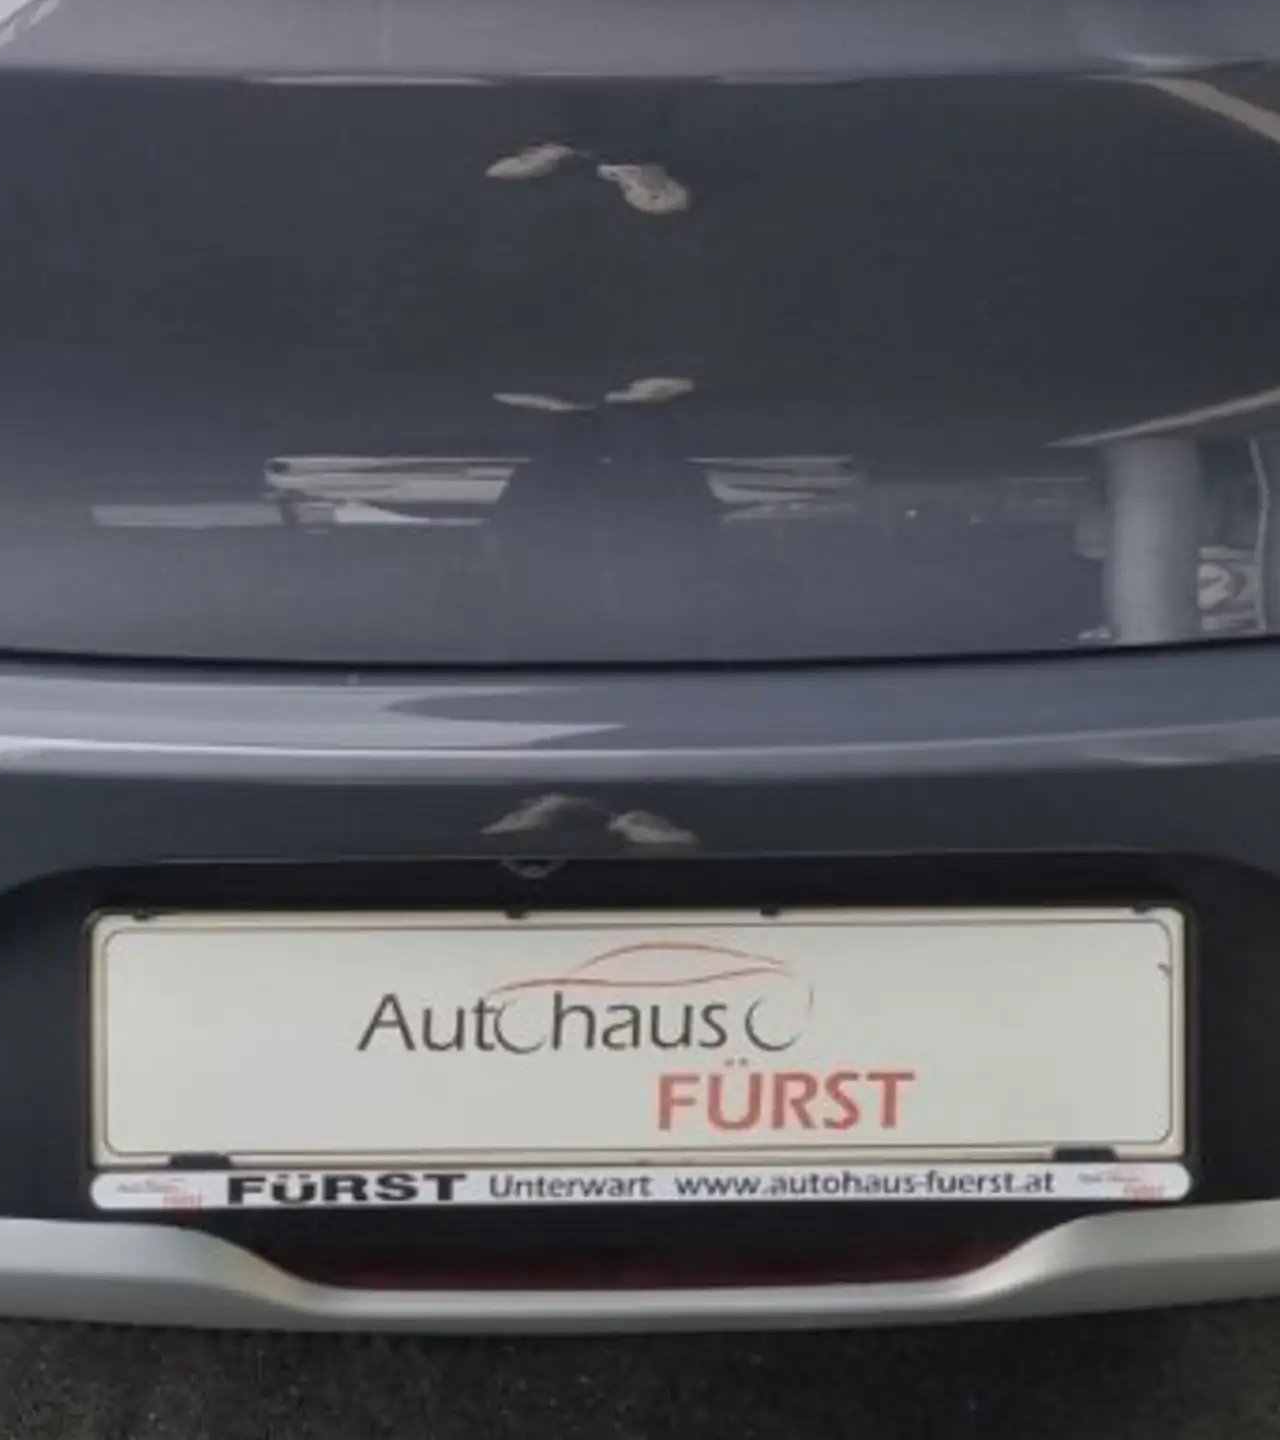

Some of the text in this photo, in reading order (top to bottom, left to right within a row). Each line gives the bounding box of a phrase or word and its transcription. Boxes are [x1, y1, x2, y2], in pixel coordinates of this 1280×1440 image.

[357, 990, 729, 1055] Autohaus
[657, 1057, 916, 1131] FÜRST
[227, 1172, 468, 1206] FÜRST
[489, 1174, 654, 1198] Unterwart
[674, 1169, 1055, 1195] www.autohaus-fuerst.at
